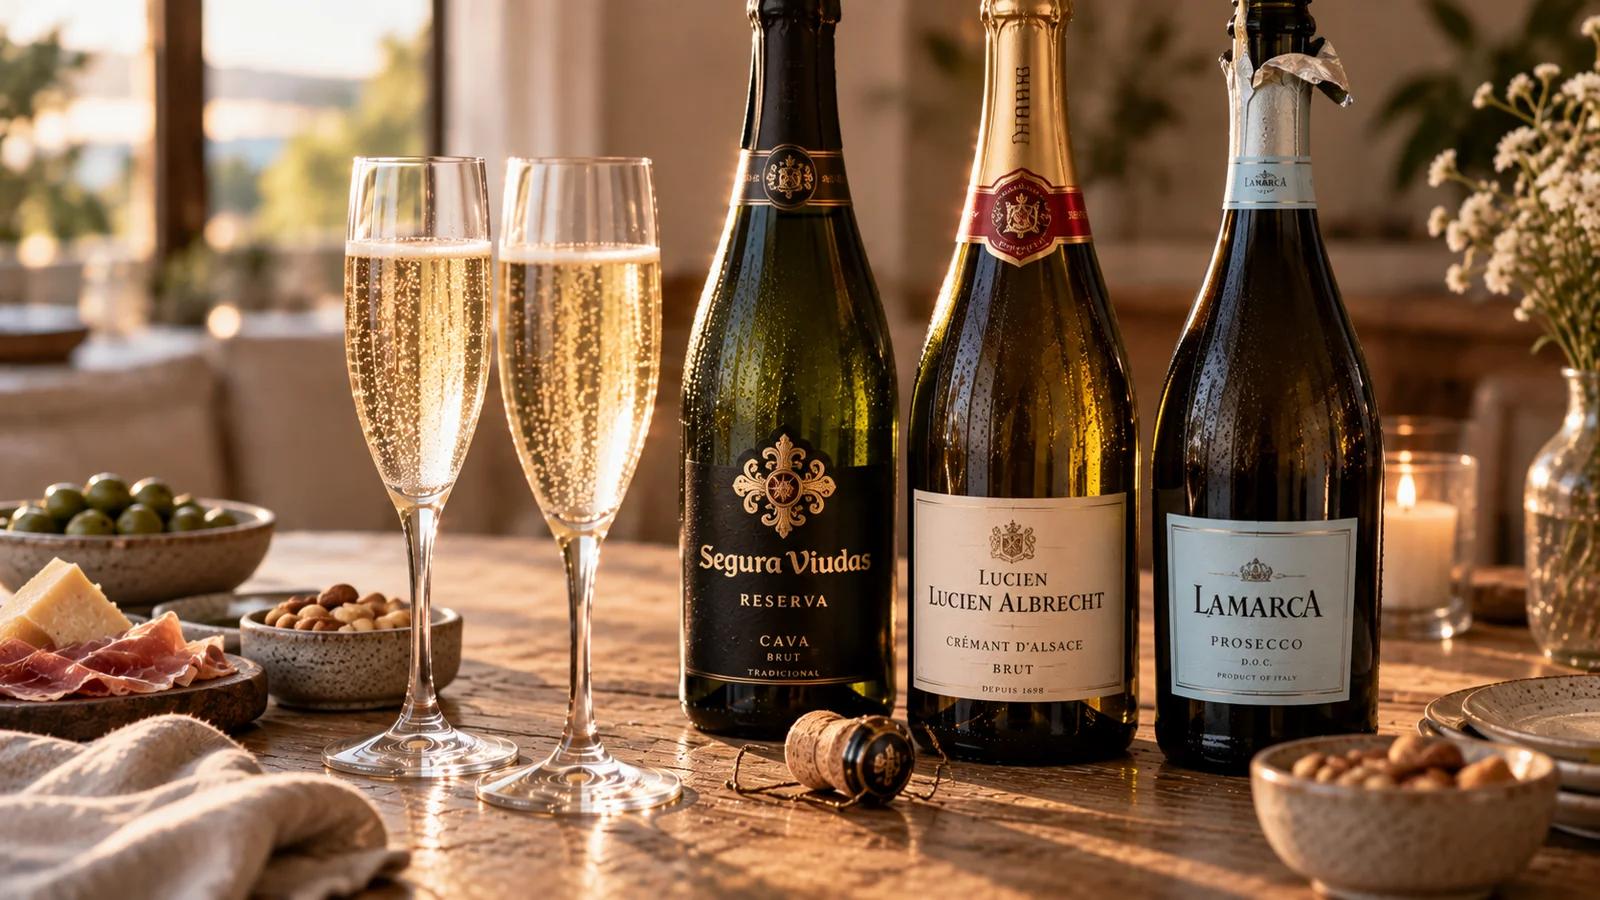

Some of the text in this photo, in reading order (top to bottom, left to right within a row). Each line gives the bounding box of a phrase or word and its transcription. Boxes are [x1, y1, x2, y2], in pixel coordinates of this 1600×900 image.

[699, 544, 871, 578] Segura Viudas
[979, 569, 1048, 586] LUCIEN
[740, 593, 828, 608] RESERVA
[928, 585, 1105, 613] LUCIEN ALBRECHT
[1193, 584, 1323, 619] LAMARCA
[759, 635, 809, 647] CAVA
[946, 635, 1083, 652] CRÉMANT D'ALSACE
[1211, 635, 1303, 650] PROSECCO
[767, 652, 801, 662] BRUT
[747, 668, 819, 677] TRADICIONAL
[993, 663, 1034, 675] BRUT
[1217, 672, 1256, 681] PRODUCT
[982, 685, 1017, 694] DEPUIS
